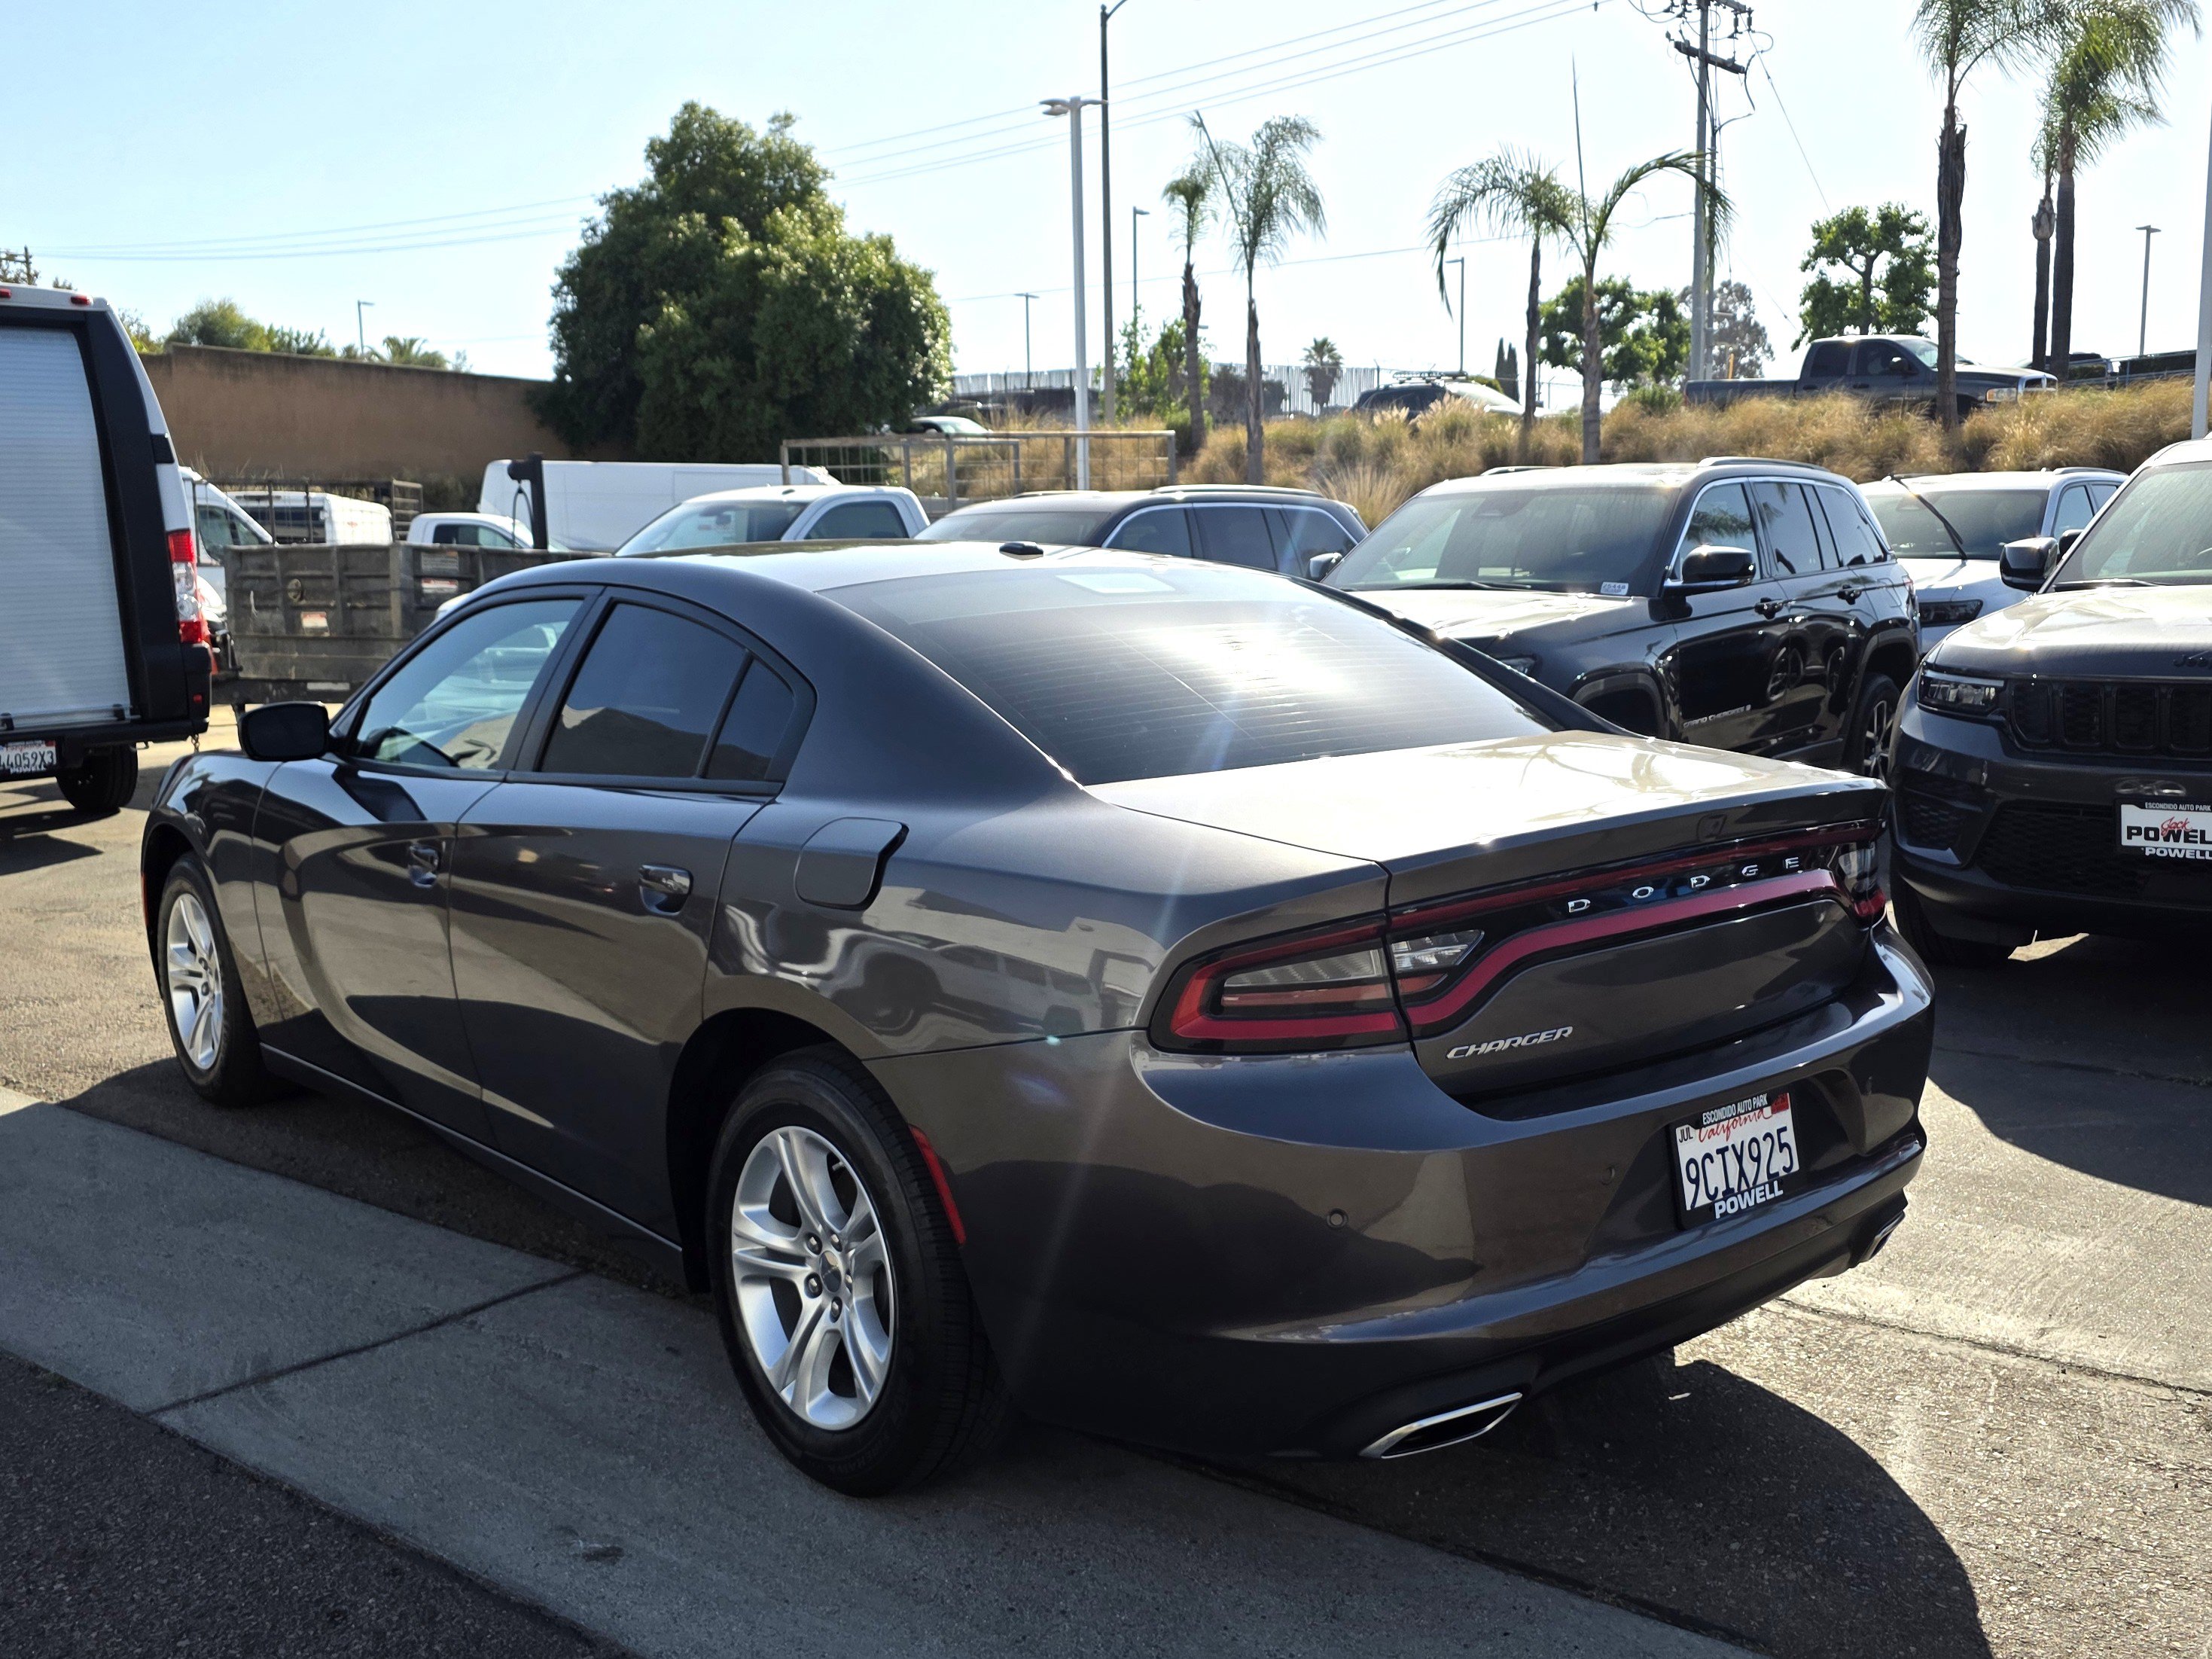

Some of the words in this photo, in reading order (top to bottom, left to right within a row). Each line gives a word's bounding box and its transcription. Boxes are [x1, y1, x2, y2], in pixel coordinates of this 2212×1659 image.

[2173, 655, 2212, 669] Jee
[2145, 802, 2177, 810] ESCONDIDO
[2127, 825, 2212, 845] POWEL
[2161, 816, 2192, 837] Jack
[1568, 856, 1799, 913] DODGE
[1446, 1026, 1574, 1060] CHARGER
[1699, 1109, 1772, 1143] California
[1702, 1105, 1736, 1126] ESCONDIDO
[1737, 1099, 1753, 1115] AUTO
[1753, 1093, 1768, 1109] PARK
[1679, 1127, 1693, 1143] JUL
[1686, 1126, 1793, 1209] 9CIX925
[1714, 1180, 1784, 1219] POWELL
